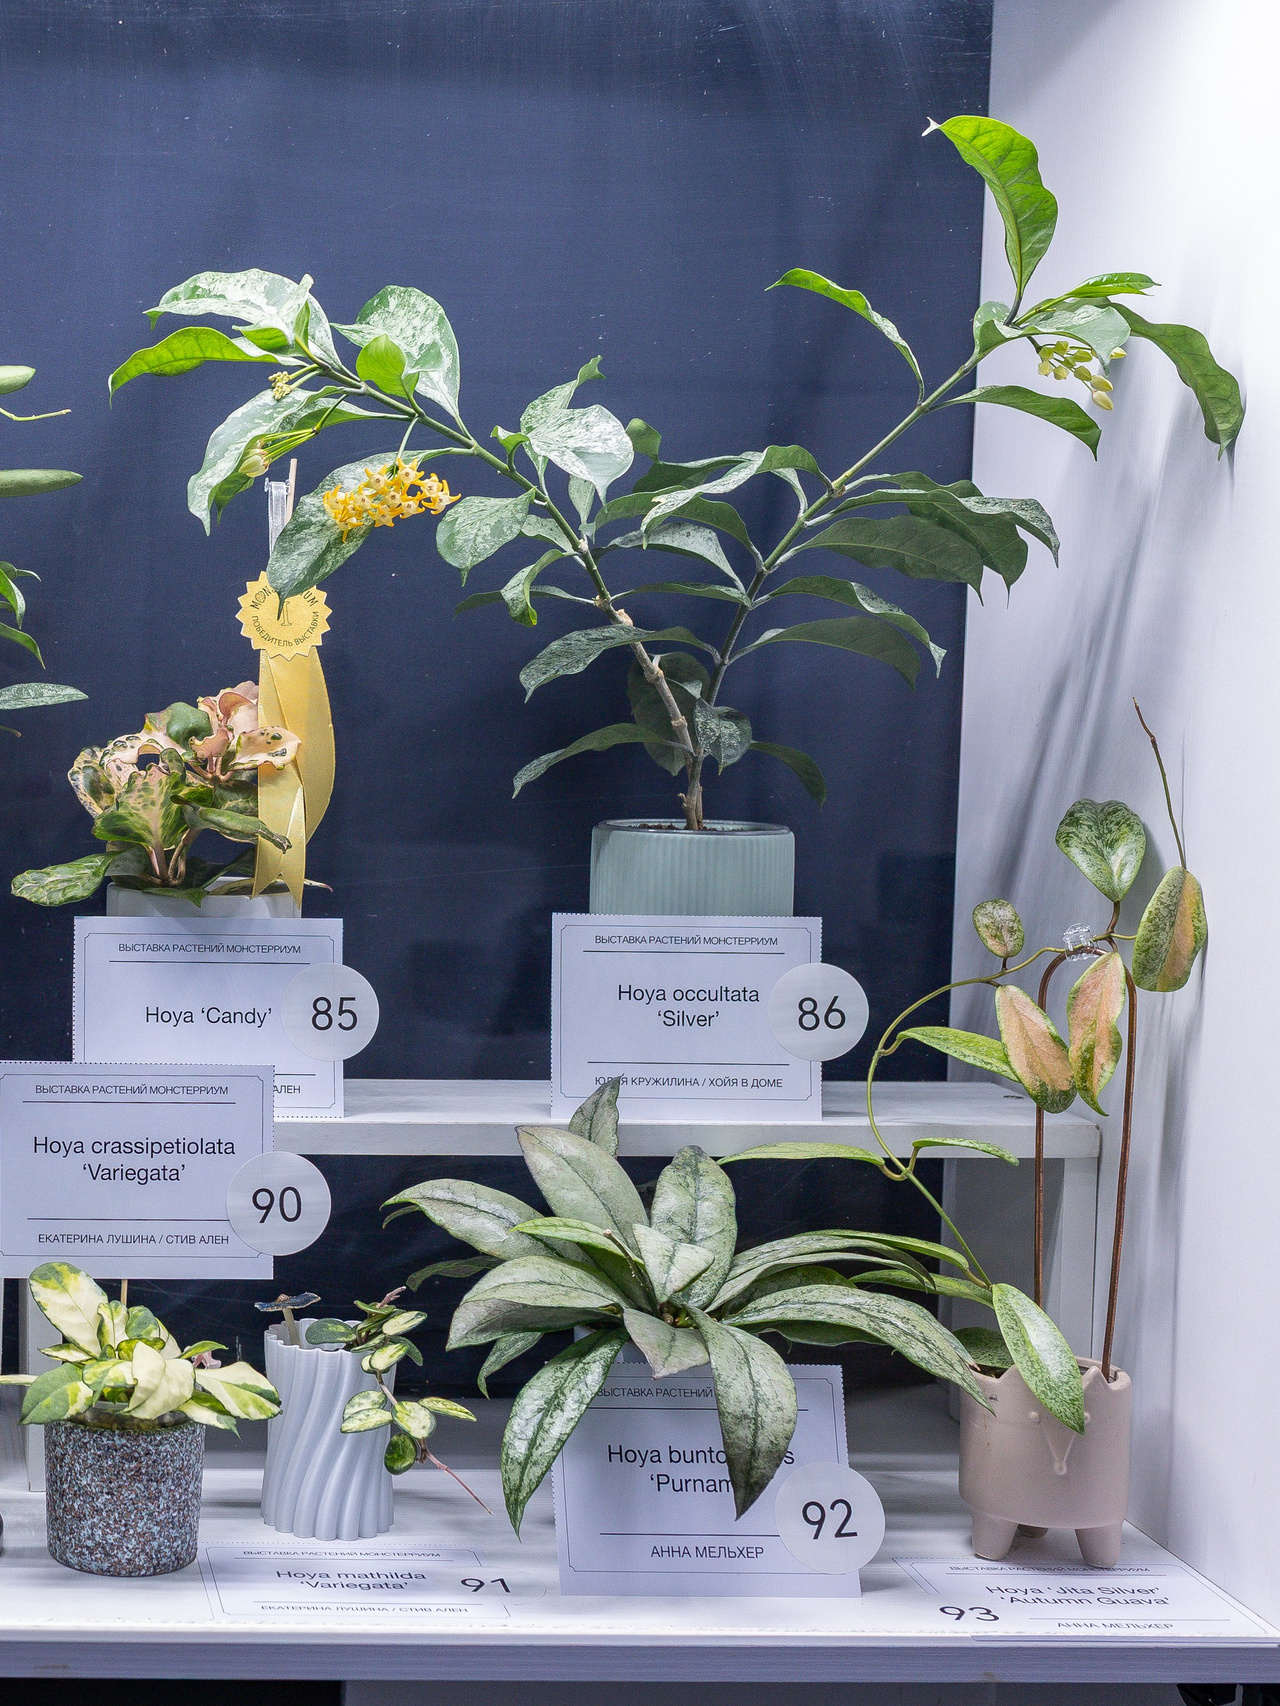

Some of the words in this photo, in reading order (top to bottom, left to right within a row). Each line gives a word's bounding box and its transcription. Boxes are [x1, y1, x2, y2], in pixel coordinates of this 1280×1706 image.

[251, 615, 294, 647] ПОБЕДИТЕЛЬ
[294, 611, 320, 646] ВЫСТАВКИ
[118, 943, 171, 953] ВЫСТАВКА
[172, 942, 225, 953] РАСТЕНИЙ
[226, 944, 301, 954] МОНСТЕРРИУМ
[595, 934, 647, 944] ВЫСТАВКА
[648, 934, 702, 945] РАСТЕНИЙ
[703, 936, 778, 946] МОНСТЕРРИУМ
[618, 984, 667, 1005] Hoya
[673, 985, 760, 1003] occultata
[145, 1006, 195, 1027] Hoya
[201, 1007, 273, 1027] ‘Candy’
[311, 996, 358, 1031] 85
[657, 1010, 720, 1027] ‘Silver’
[797, 995, 846, 1032] 86
[35, 1084, 90, 1095] ВЫСТАВКА
[91, 1083, 148, 1095] РАСТЕНИЙ
[148, 1085, 229, 1096] МОНСТЕРРИУМ
[273, 1084, 301, 1094] АЛЕН
[631, 1076, 700, 1087] КРУЖИЛИНА
[708, 1075, 739, 1088] ХОЙЯ
[741, 1078, 749, 1088] В
[750, 1078, 783, 1090] ДОМЕ
[33, 1136, 85, 1158] Hoya
[91, 1137, 236, 1159] crassipetiolata
[82, 1164, 187, 1186] ‘Variegata’
[251, 1186, 302, 1224] 90
[38, 1233, 104, 1244] ЕКАТЕРИНА
[105, 1233, 157, 1246] ЛУШИНА
[165, 1234, 197, 1245] СТИВ
[198, 1234, 229, 1245] АЛЕН
[596, 1387, 654, 1397] ВЫСТАВКА
[655, 1386, 714, 1398] РАСТЕНИЙ
[607, 1444, 662, 1468] Hoya
[801, 1498, 858, 1541] 92
[650, 1545, 692, 1558] АННА
[695, 1546, 765, 1559] МЕЛЬХЕР
[275, 1570, 330, 1581] Hoya
[337, 1571, 427, 1580] mathilda
[299, 1581, 409, 1591] ‘Variegata’
[460, 1577, 511, 1594] 91
[985, 1586, 1042, 1595] Hoya
[1096, 1586, 1160, 1595] Silver’
[1000, 1596, 1088, 1605] ‘Autumn
[1095, 1597, 1170, 1606] Guava’
[939, 1605, 1000, 1622] 93
[1056, 1621, 1104, 1629] АННА
[1104, 1621, 1174, 1630] МЕЛЬХЕР
